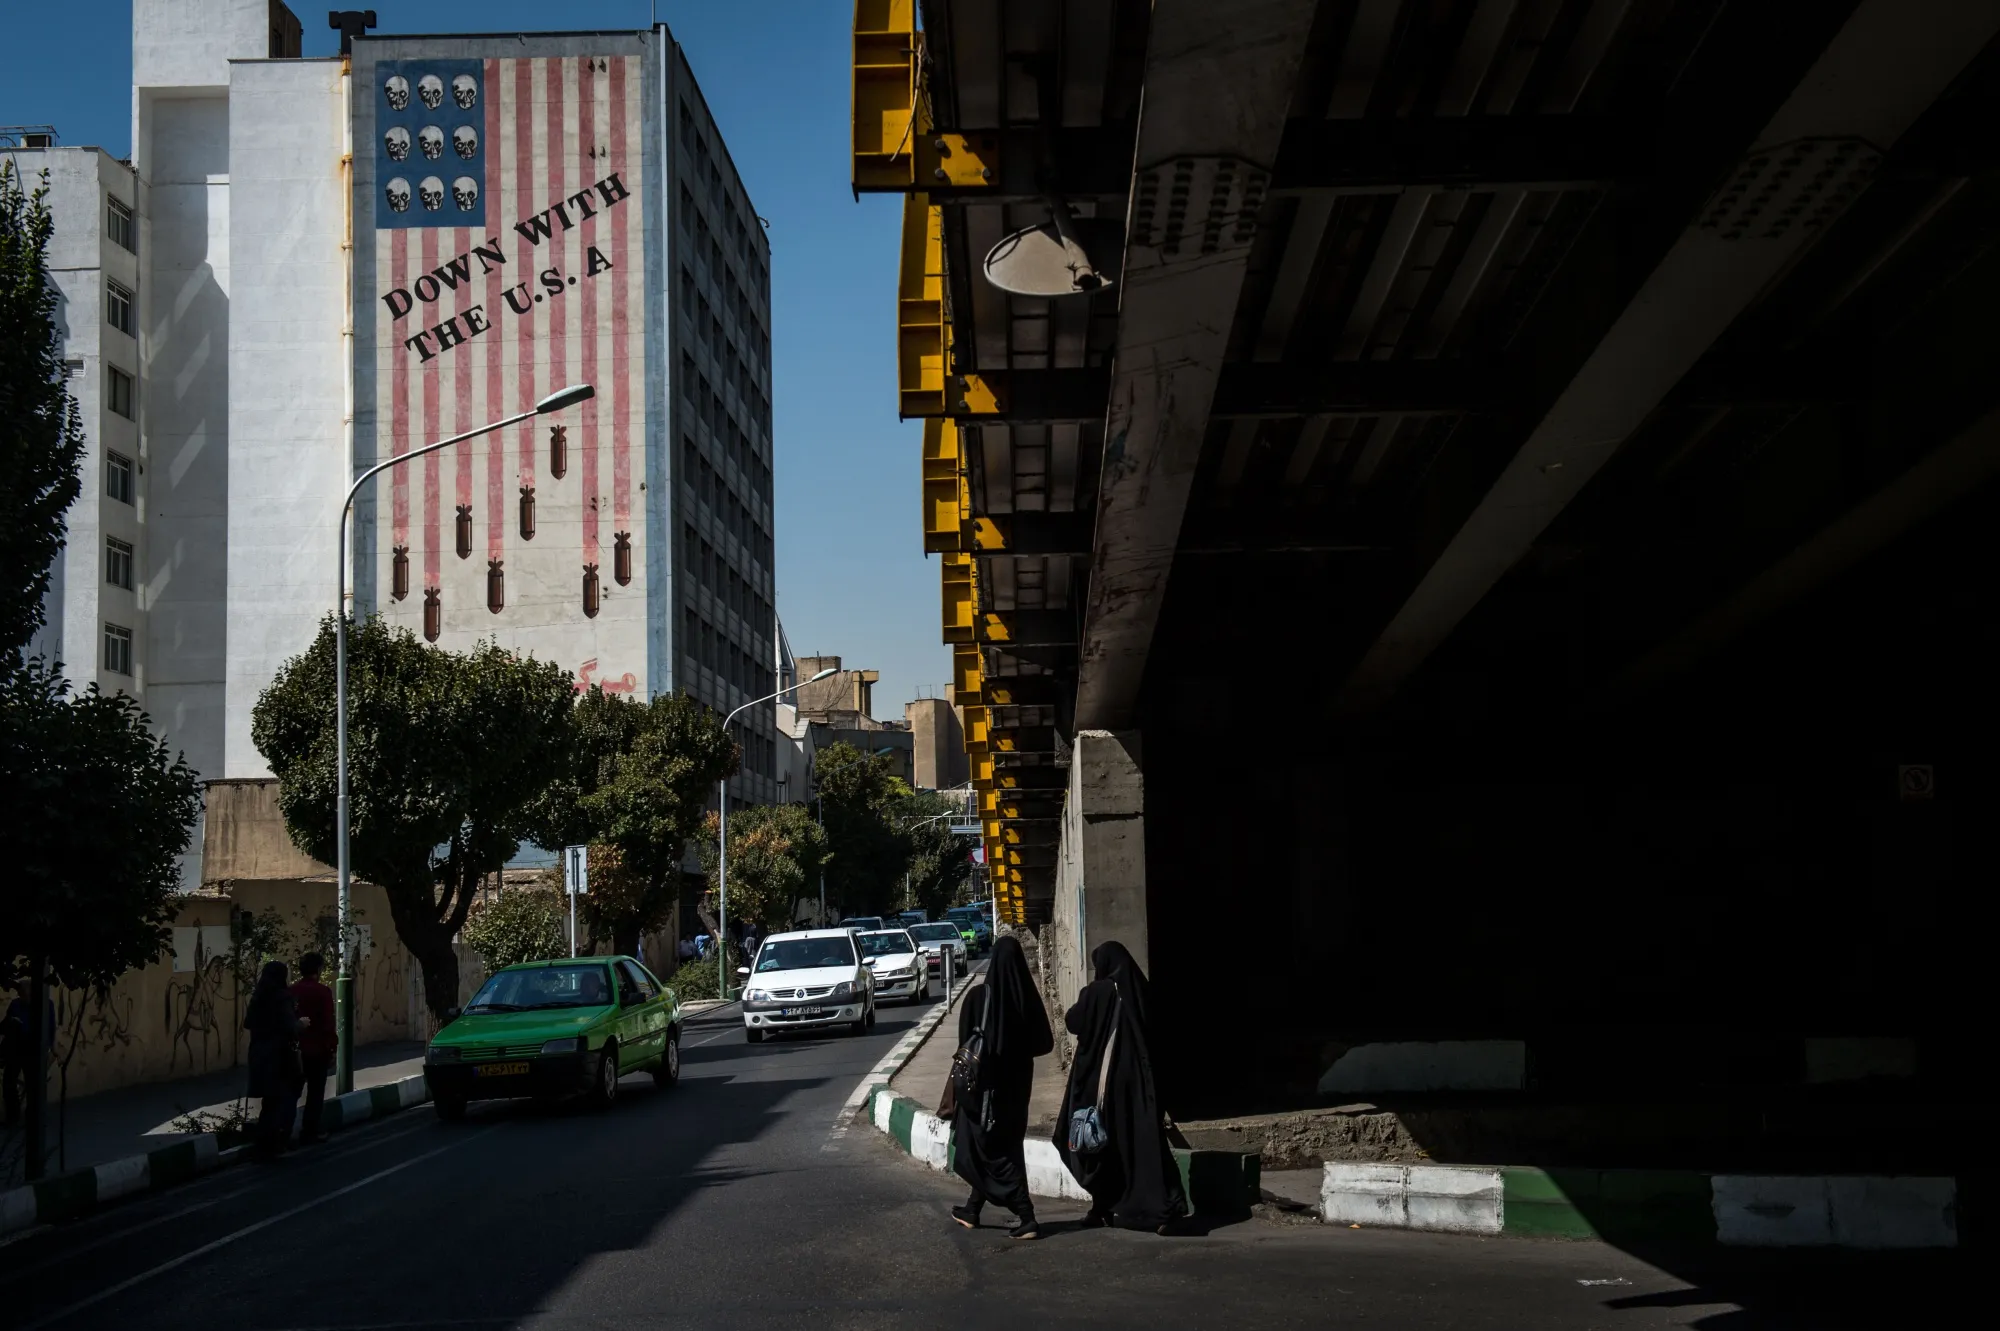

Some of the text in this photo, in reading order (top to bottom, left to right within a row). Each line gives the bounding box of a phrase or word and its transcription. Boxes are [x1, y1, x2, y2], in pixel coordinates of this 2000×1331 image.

[381, 172, 630, 321] DOWN WITH
[404, 304, 492, 364] THE
